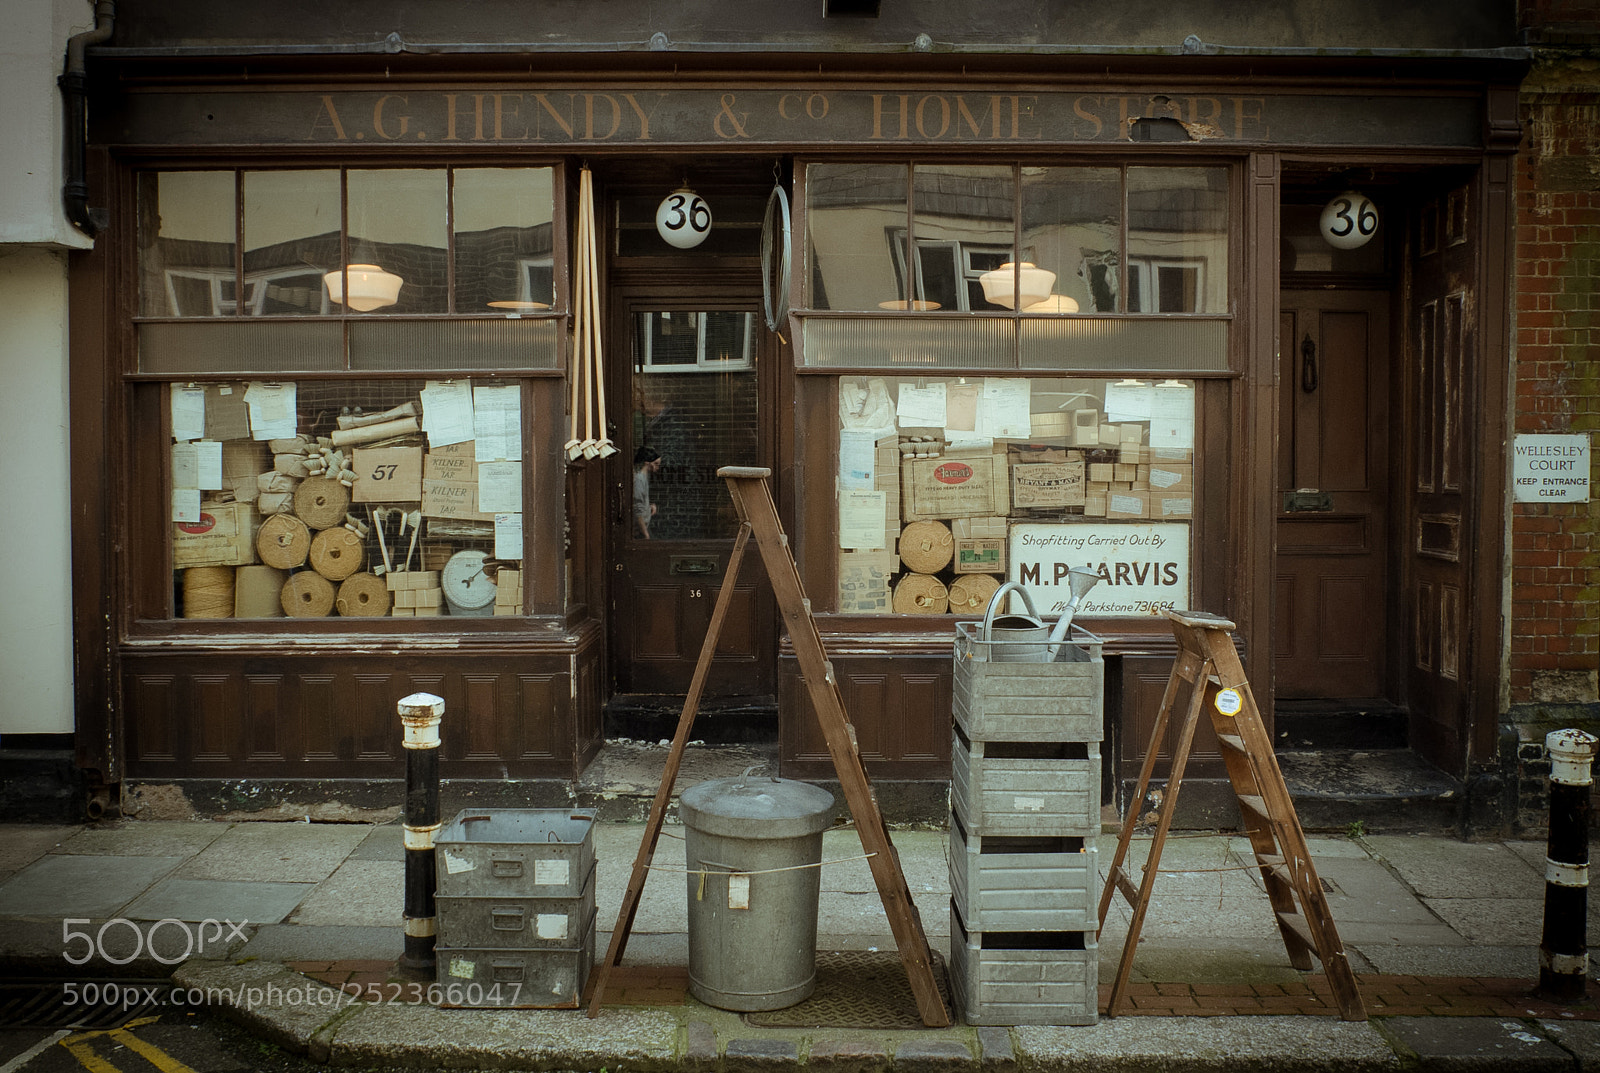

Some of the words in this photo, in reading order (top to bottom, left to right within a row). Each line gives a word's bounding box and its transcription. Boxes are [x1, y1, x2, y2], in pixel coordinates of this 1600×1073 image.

[304, 94, 427, 141] A.G.
[441, 93, 669, 141] HENDY
[712, 93, 753, 139] &
[867, 94, 1042, 140] HOME
[664, 194, 711, 233] 36
[1330, 198, 1377, 237] 36
[1515, 446, 1586, 457] WELLESLEY
[432, 458, 465, 467] KILNER
[1529, 460, 1576, 470] COURT
[371, 464, 399, 481] 57
[1516, 477, 1538, 485] KEEP
[1542, 477, 1588, 485] ENTRANCE
[430, 485, 468, 497] KILNER
[439, 505, 457, 515] JAR
[1022, 534, 1085, 550] Shopfitting
[1087, 534, 1126, 546] Carried
[1129, 534, 1150, 546] Out
[1151, 534, 1167, 549] By
[1019, 562, 1071, 586] M.P
[1085, 562, 1179, 586] ARVIS
[690, 589, 702, 598] 36
[1083, 600, 1133, 612] Parkstone
[1133, 601, 1175, 613] 731684
